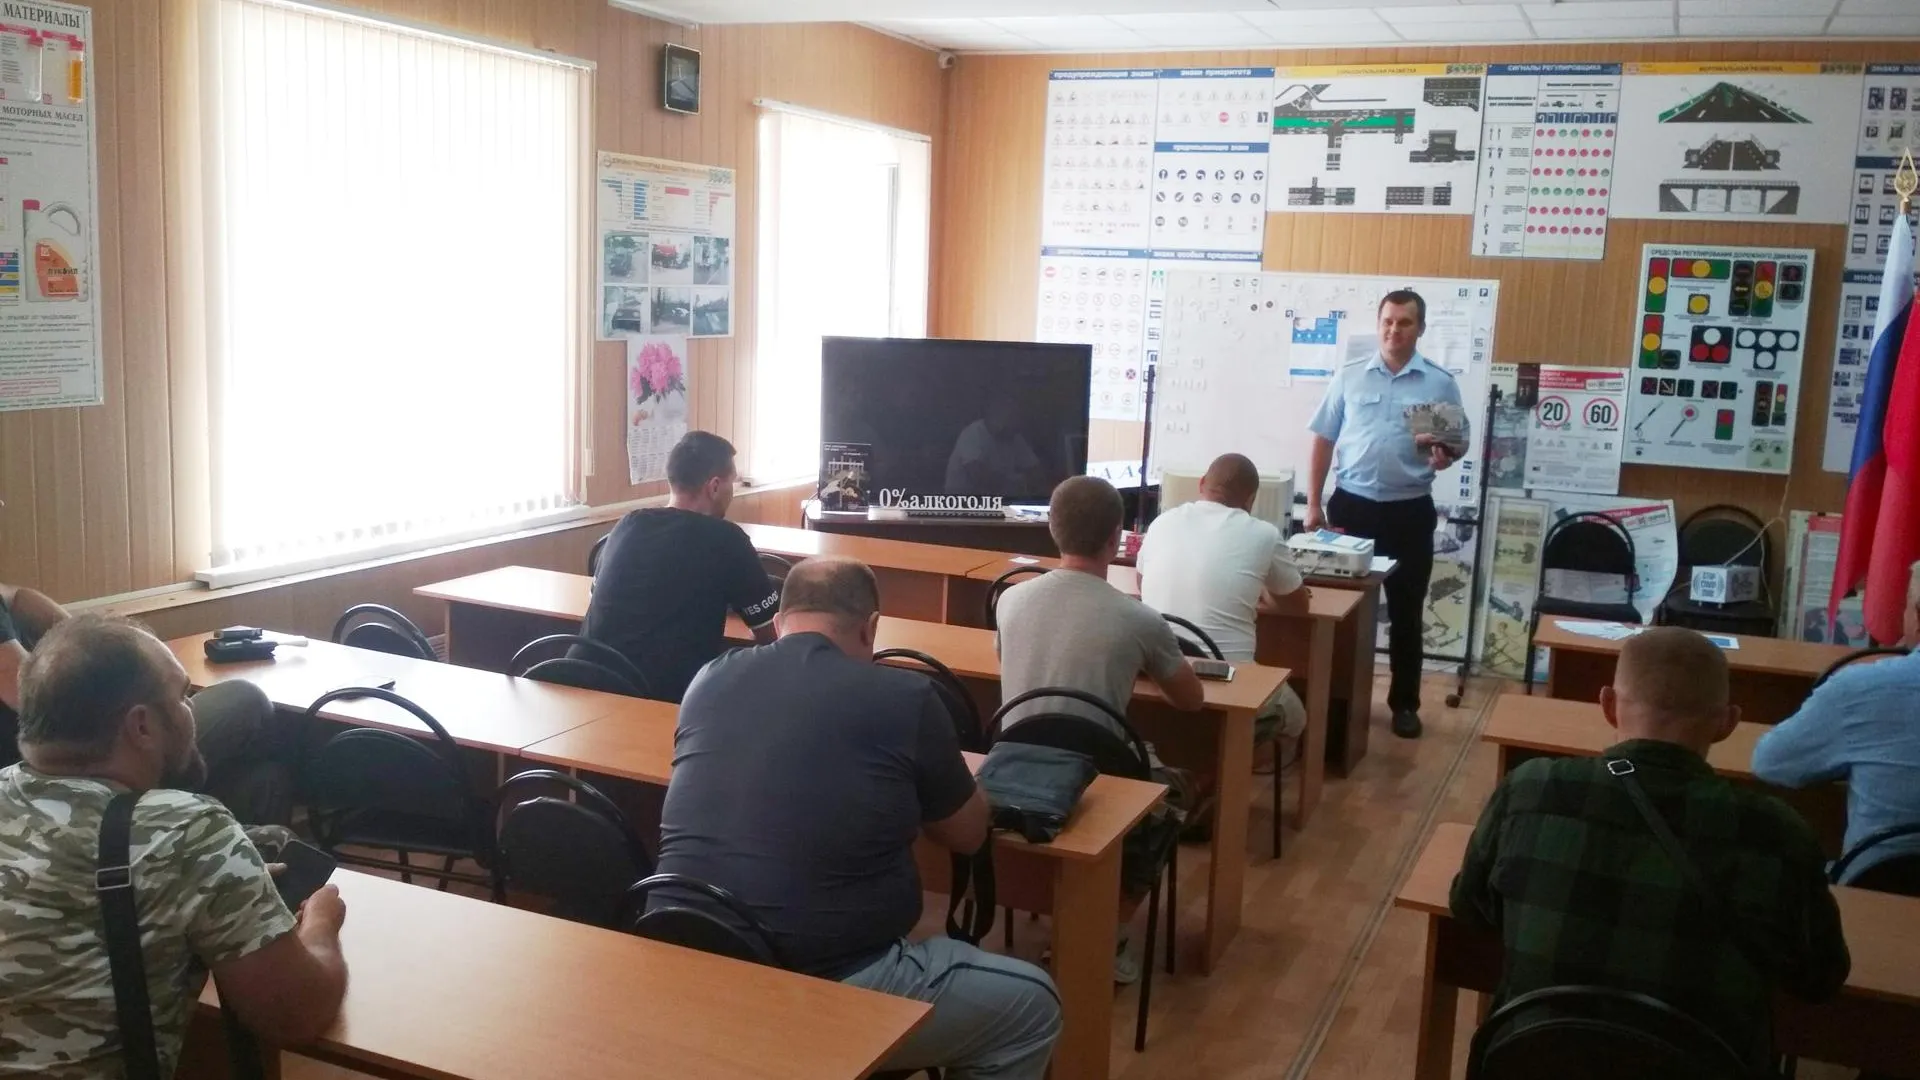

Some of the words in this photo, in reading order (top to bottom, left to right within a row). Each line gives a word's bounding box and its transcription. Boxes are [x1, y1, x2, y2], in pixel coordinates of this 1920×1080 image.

[3, 2, 80, 28] МАТЕРИАЛЫ
[2, 105, 52, 118] МОТОРНЫХ
[55, 111, 84, 122] МАСЕЛ
[1543, 402, 1564, 421] 20
[1590, 404, 1612, 424] 60
[879, 488, 1003, 510] 0%алкоголя
[745, 604, 761, 616] ES
